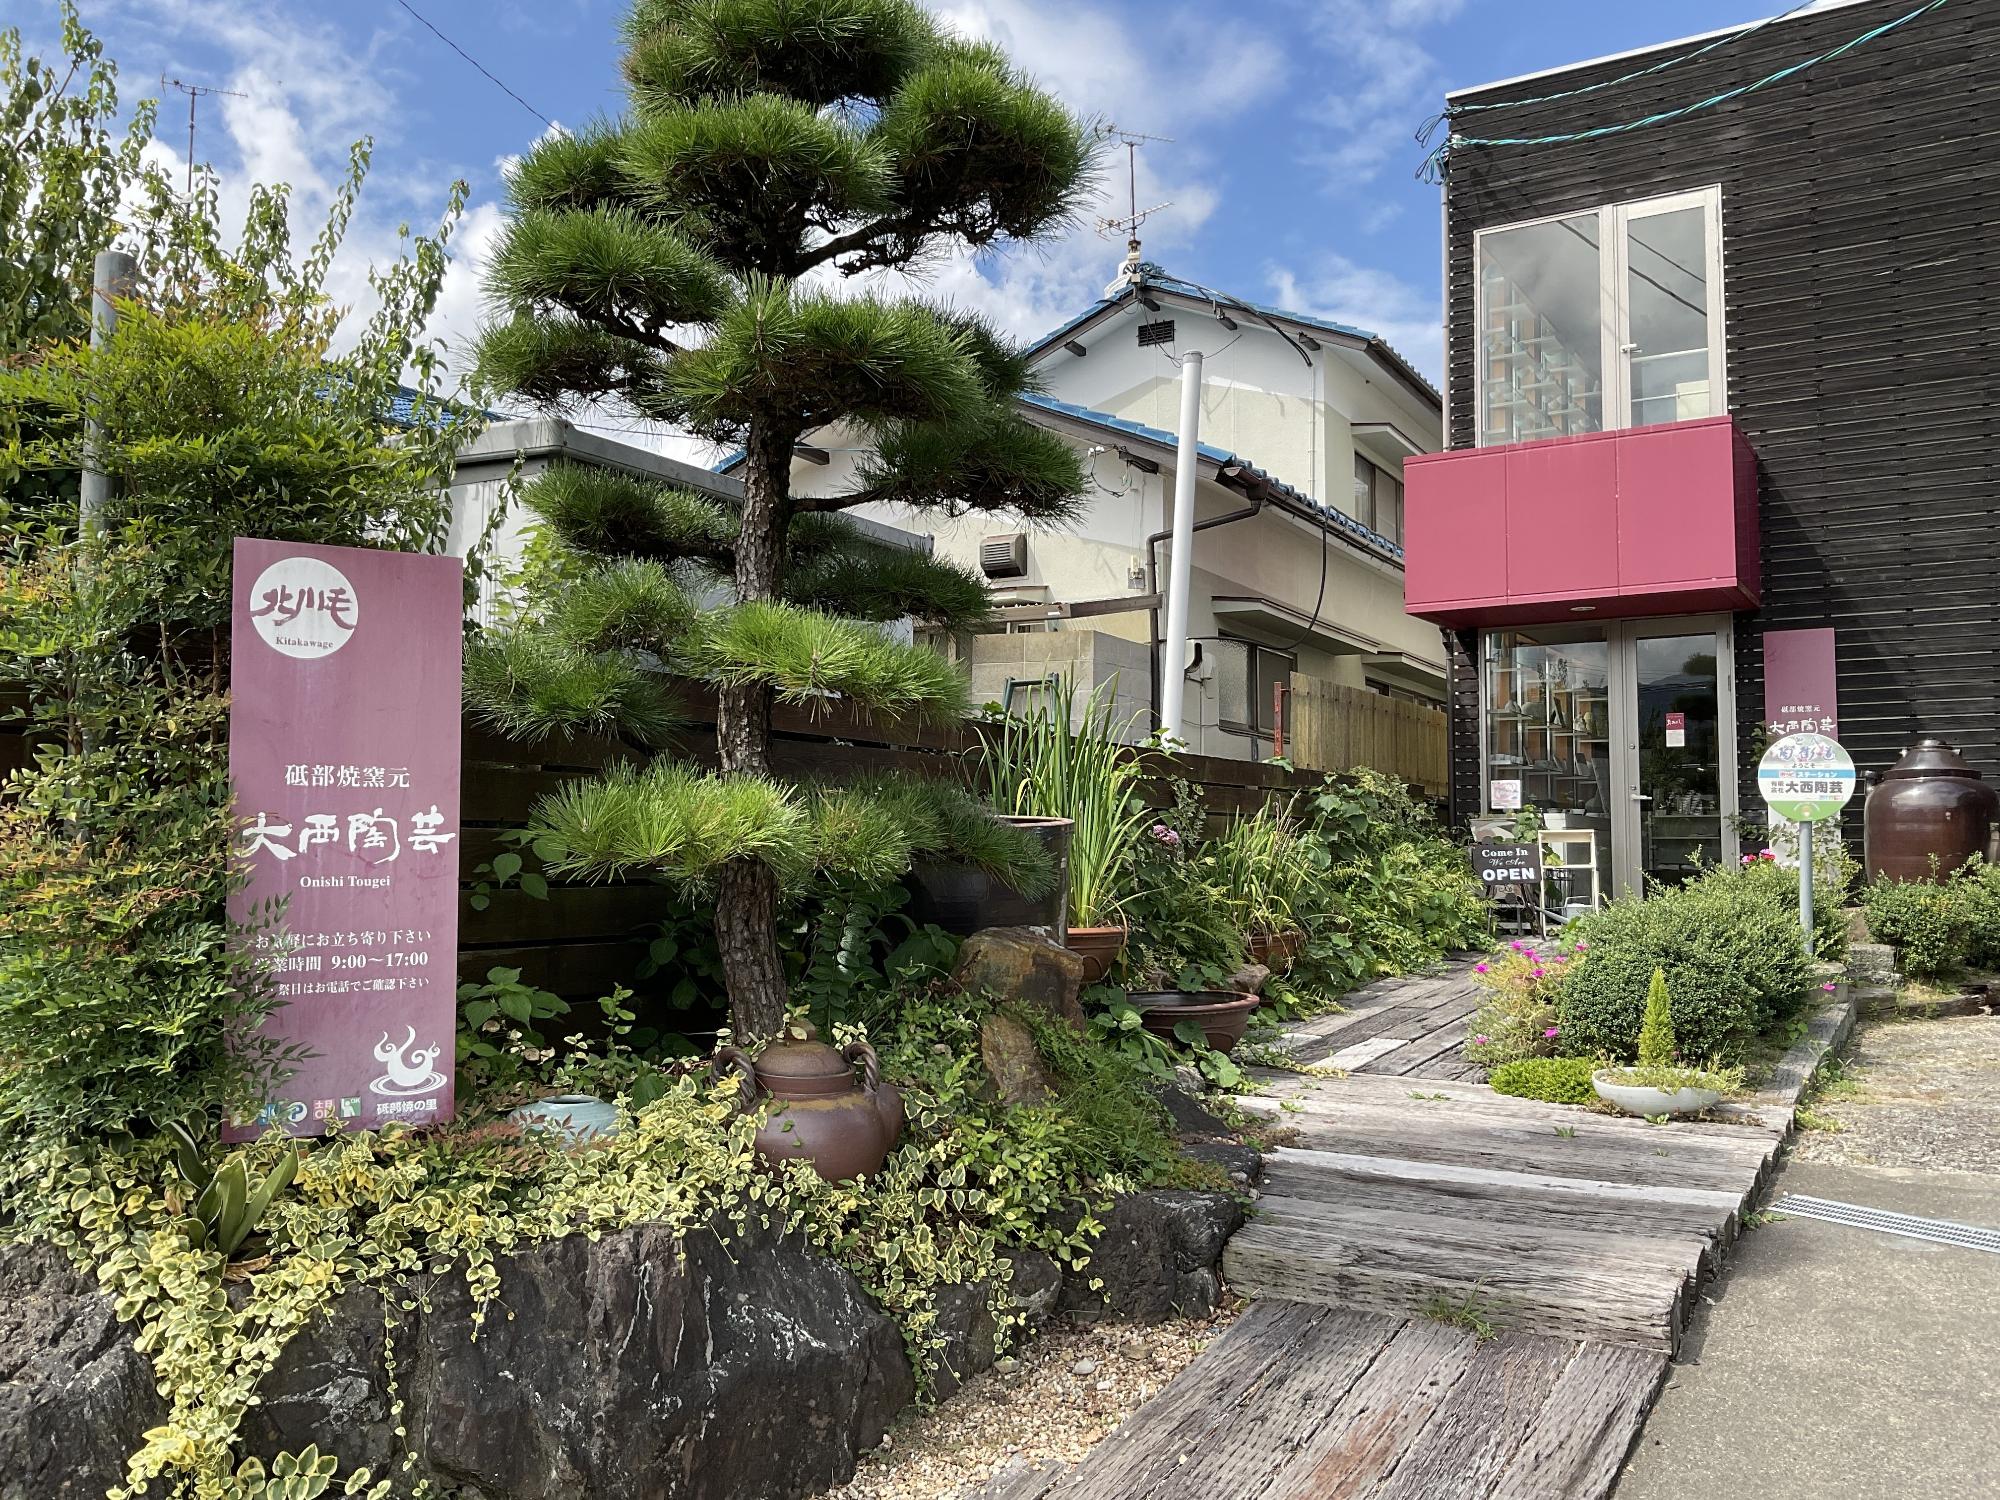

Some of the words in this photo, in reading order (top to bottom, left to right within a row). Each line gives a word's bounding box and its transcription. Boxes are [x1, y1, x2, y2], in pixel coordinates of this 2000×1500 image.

[276, 635, 334, 649] Kitakawage
[1767, 716, 1836, 735] 大西陶芸
[284, 764, 411, 788] 砥部焼窯元
[1786, 781, 1844, 794] 大西陶芸
[241, 805, 456, 865] 大西陶芸
[1481, 849, 1513, 858] Come
[1515, 848, 1528, 856] In
[300, 876, 344, 887] Onishi
[347, 875, 391, 888] Tougei
[1482, 867, 1535, 881] OPEN
[255, 977, 430, 996] ・祭日はお電話でご確認下さい
[376, 1099, 437, 1115] 砥部焼の里
